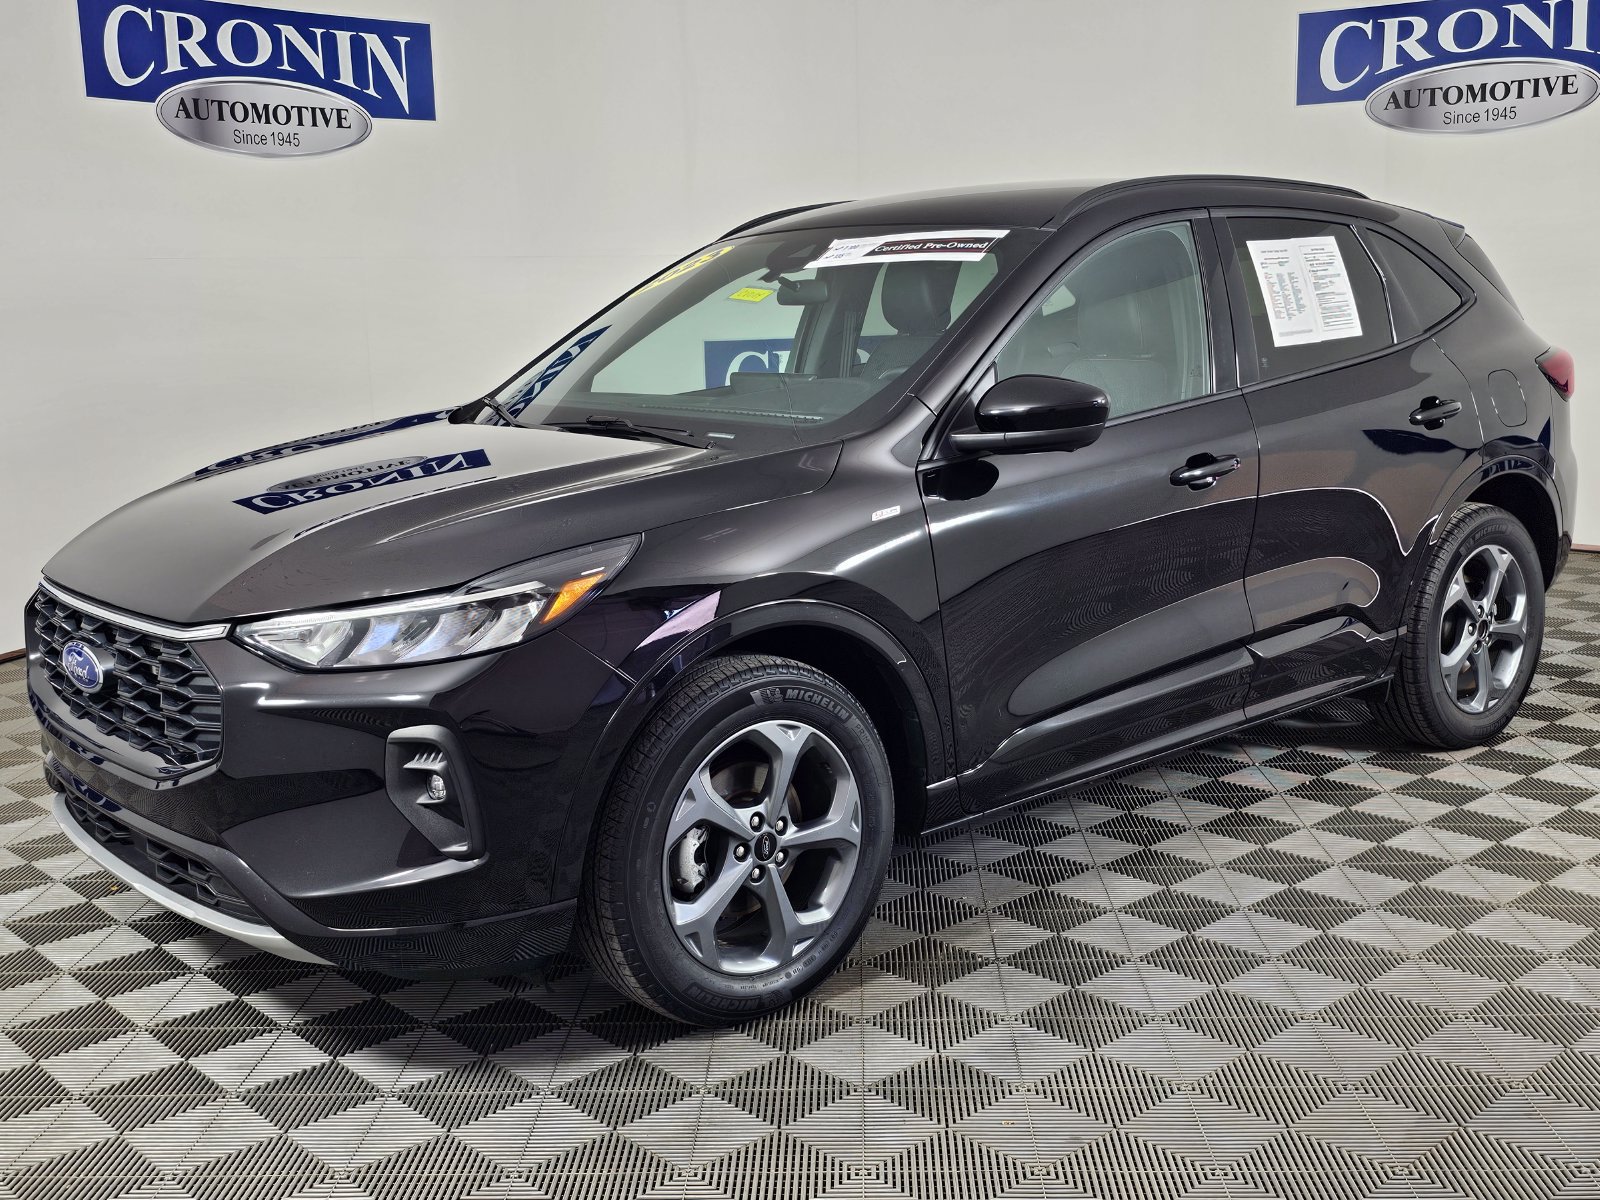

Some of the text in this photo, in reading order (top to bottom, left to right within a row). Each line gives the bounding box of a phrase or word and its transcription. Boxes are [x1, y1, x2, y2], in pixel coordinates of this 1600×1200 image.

[103, 4, 411, 115] CRONIN
[1319, 0, 1600, 92] CRONI
[1383, 74, 1580, 111] AUTOMOTIVE
[174, 97, 352, 130] AUTOMOTIVE
[1442, 106, 1517, 125] Since 1945
[233, 129, 301, 147] Since 1945
[874, 243, 923, 252] Certified
[923, 241, 989, 250] Pre-Owned
[67, 652, 92, 682] Ford
[785, 688, 850, 720] MICHELIN
